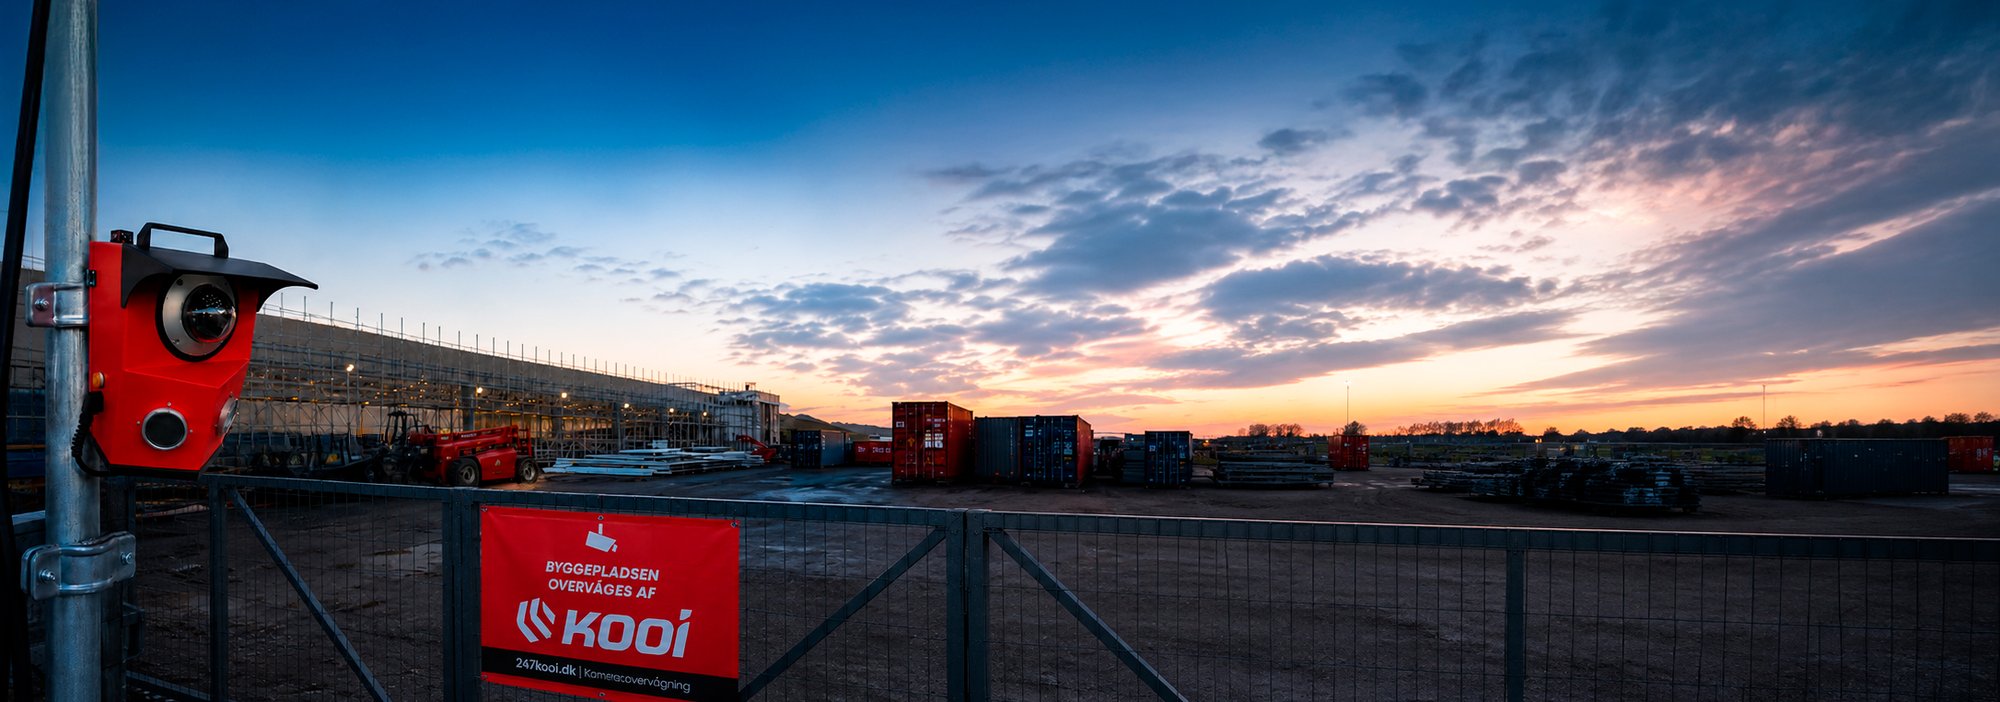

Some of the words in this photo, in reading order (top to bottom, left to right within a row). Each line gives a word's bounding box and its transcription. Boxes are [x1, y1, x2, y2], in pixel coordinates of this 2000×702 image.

[545, 561, 660, 582] BYGGEPLADSEN
[548, 578, 633, 598] OVERVÅGES
[636, 586, 657, 599] AF
[515, 657, 577, 677] 247kooi.dk
